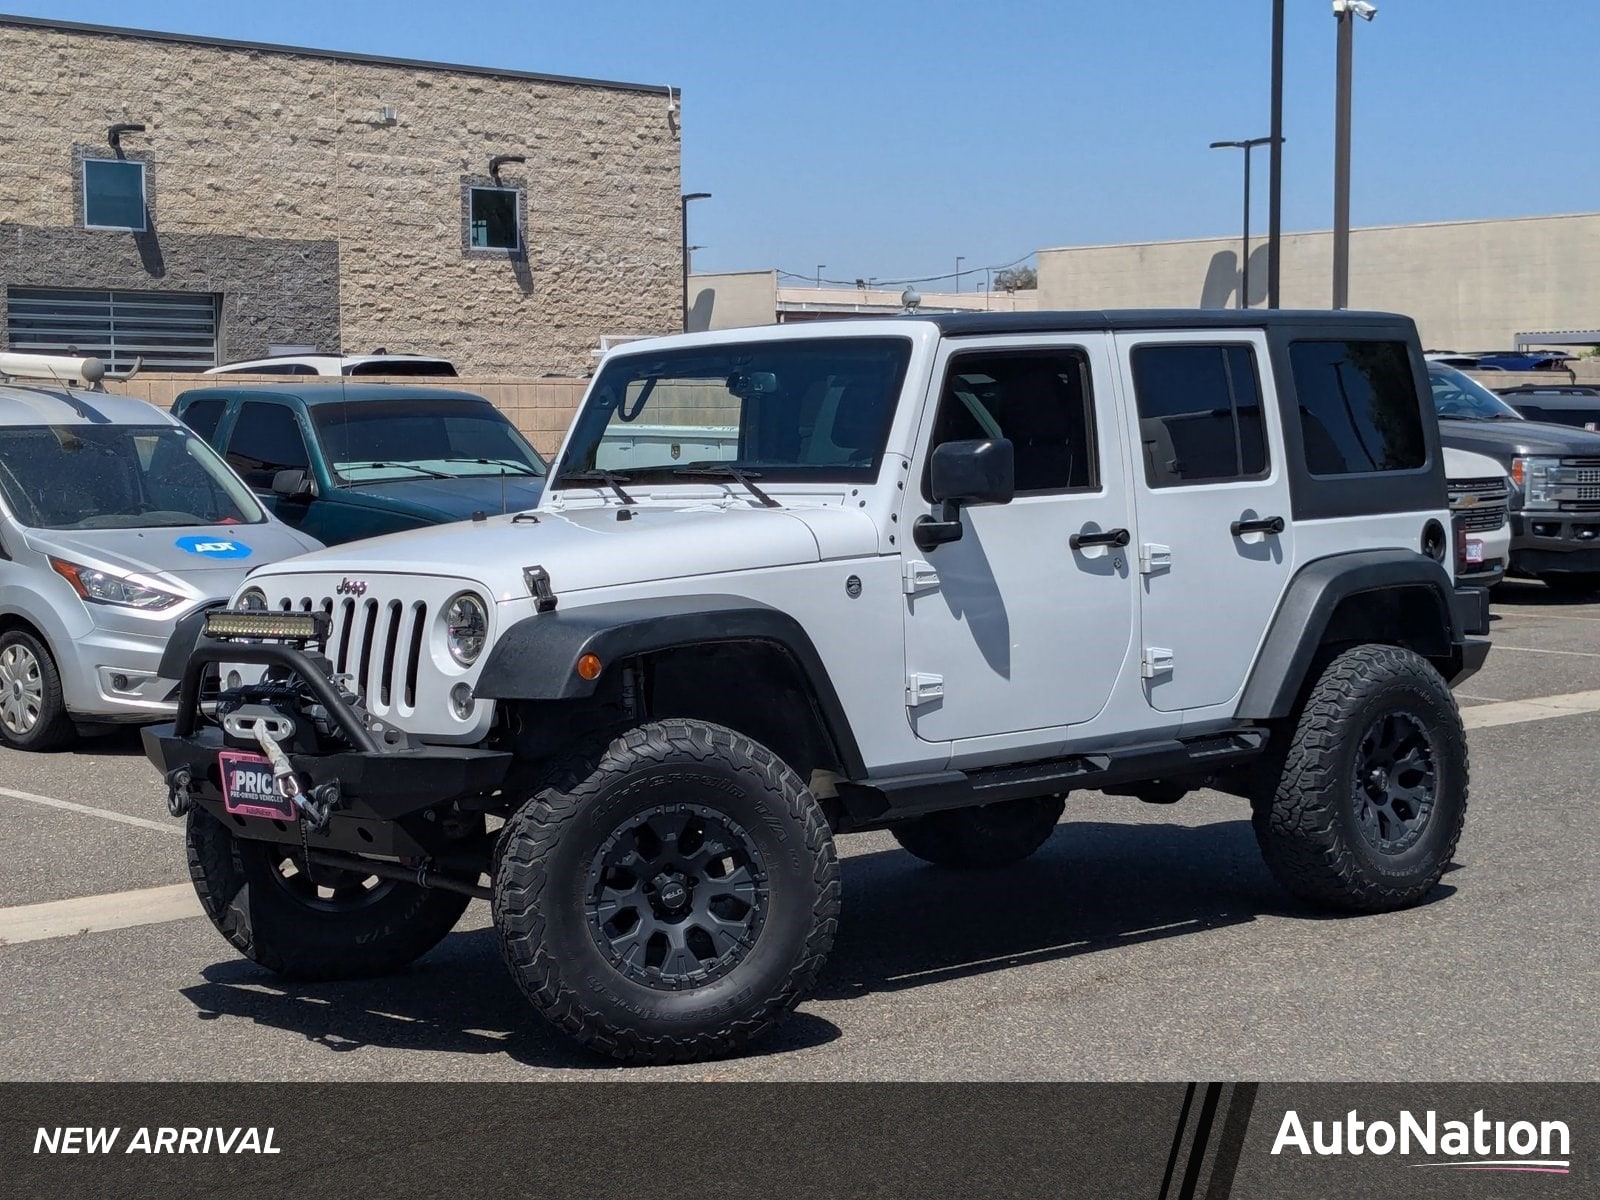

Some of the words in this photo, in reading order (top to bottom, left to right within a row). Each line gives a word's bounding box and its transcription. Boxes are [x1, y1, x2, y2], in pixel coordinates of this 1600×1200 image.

[194, 542, 237, 553] ADT
[336, 577, 368, 598] Jeep
[230, 790, 259, 800] PRE-OWNED
[259, 793, 284, 803] VEHICLES
